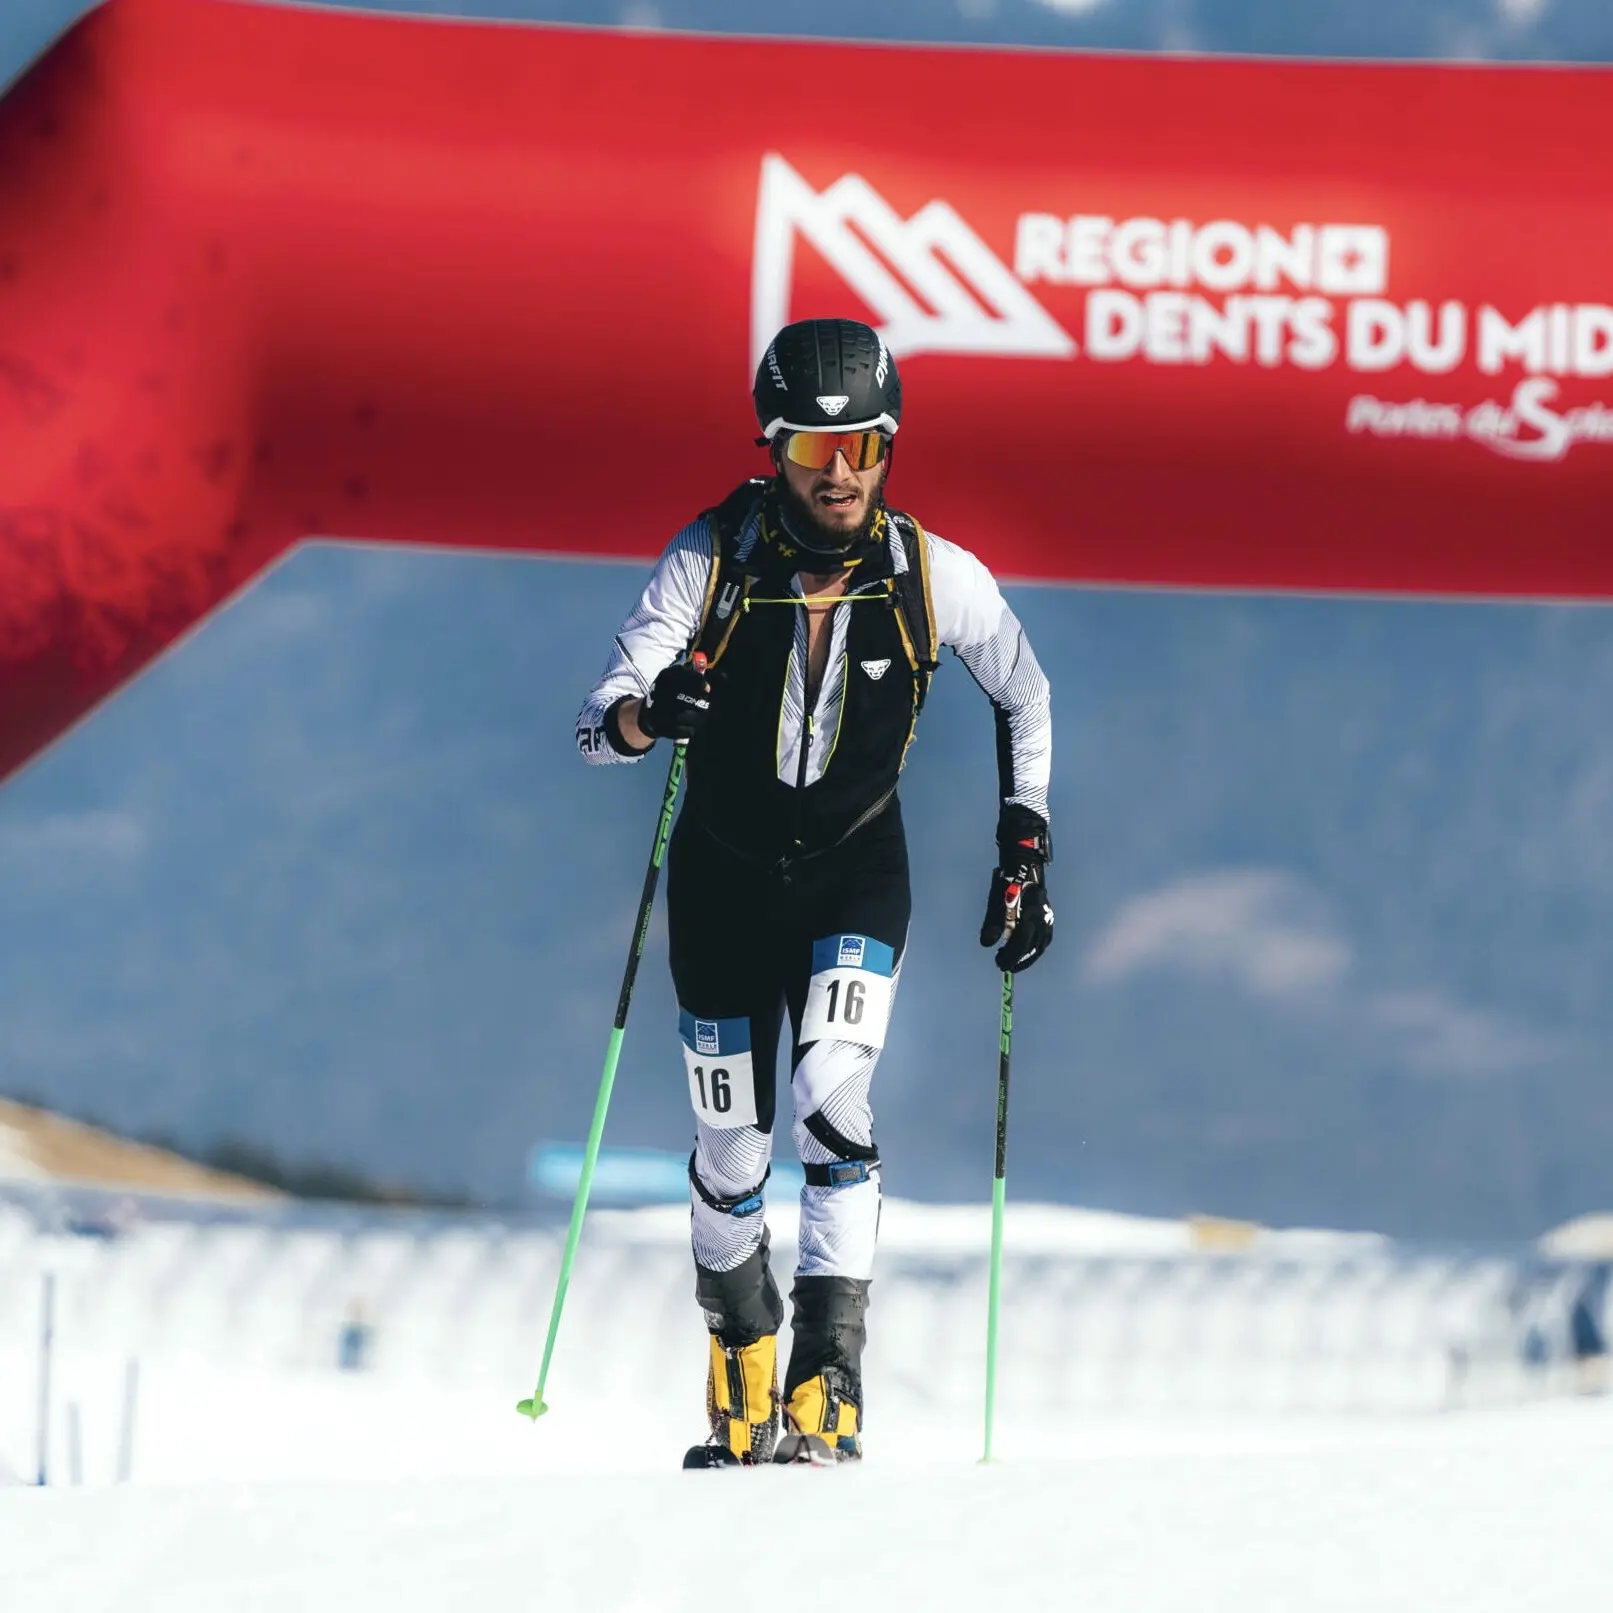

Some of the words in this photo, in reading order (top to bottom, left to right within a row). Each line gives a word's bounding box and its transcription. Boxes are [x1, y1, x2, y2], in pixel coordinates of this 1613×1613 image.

[1015, 212, 1316, 291] REGION
[1085, 288, 1338, 371] DENTS
[1346, 298, 1468, 374] DU
[1476, 302, 1613, 379] MID
[826, 979, 866, 1025] 16
[699, 1033, 715, 1042] ISMF
[694, 1066, 731, 1113] 16
